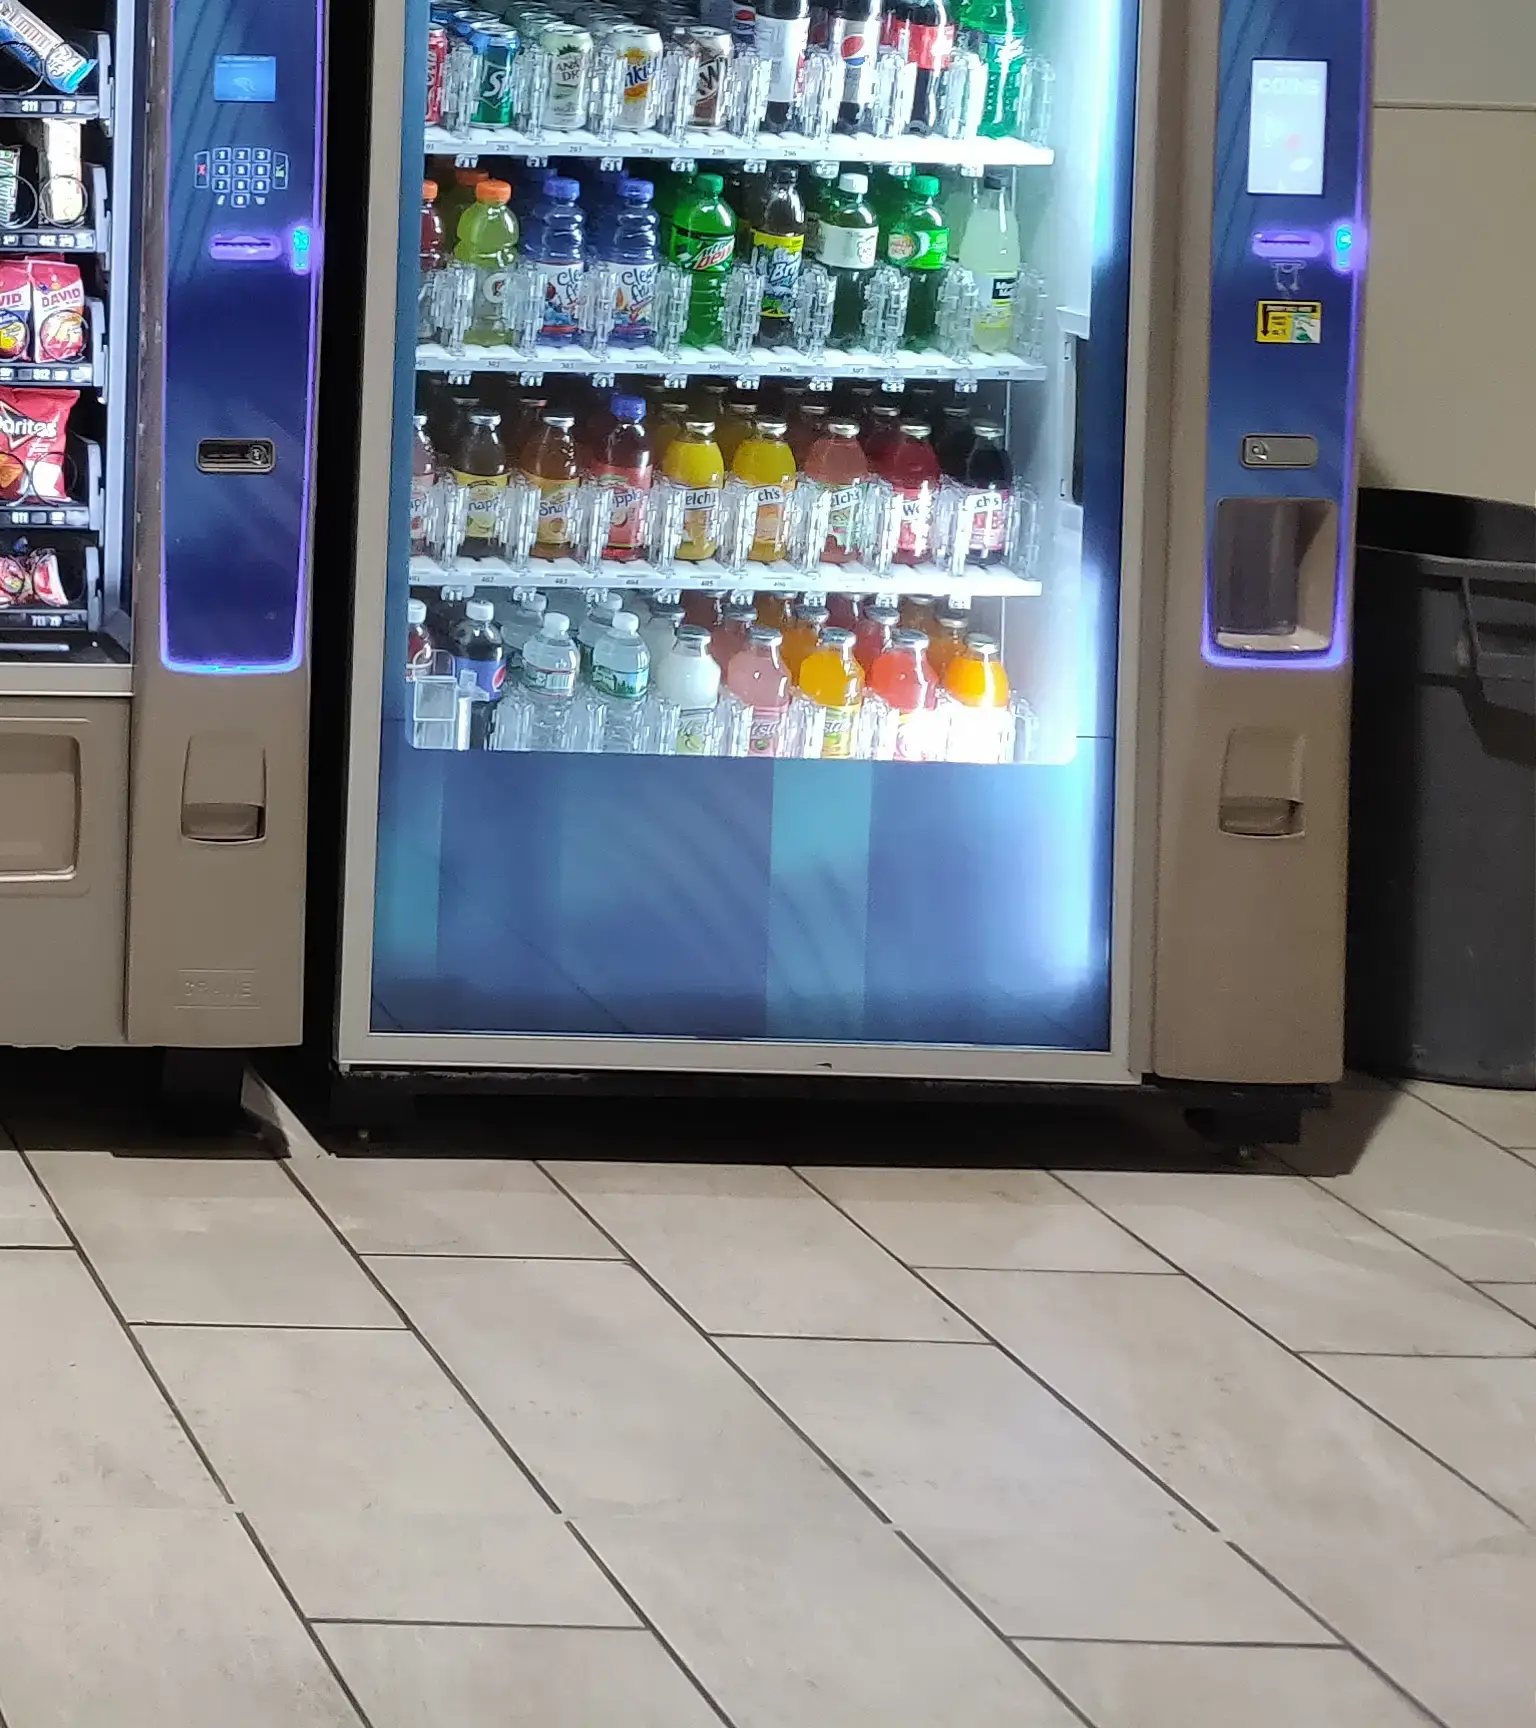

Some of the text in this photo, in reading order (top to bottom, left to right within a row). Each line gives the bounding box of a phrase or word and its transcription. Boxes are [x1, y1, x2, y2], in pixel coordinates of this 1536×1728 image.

[22, 101, 38, 113] 311
[42, 287, 81, 308] DAVID
[758, 488, 781, 502] ch's
[831, 488, 861, 509] elch's
[539, 497, 574, 518] Snap
